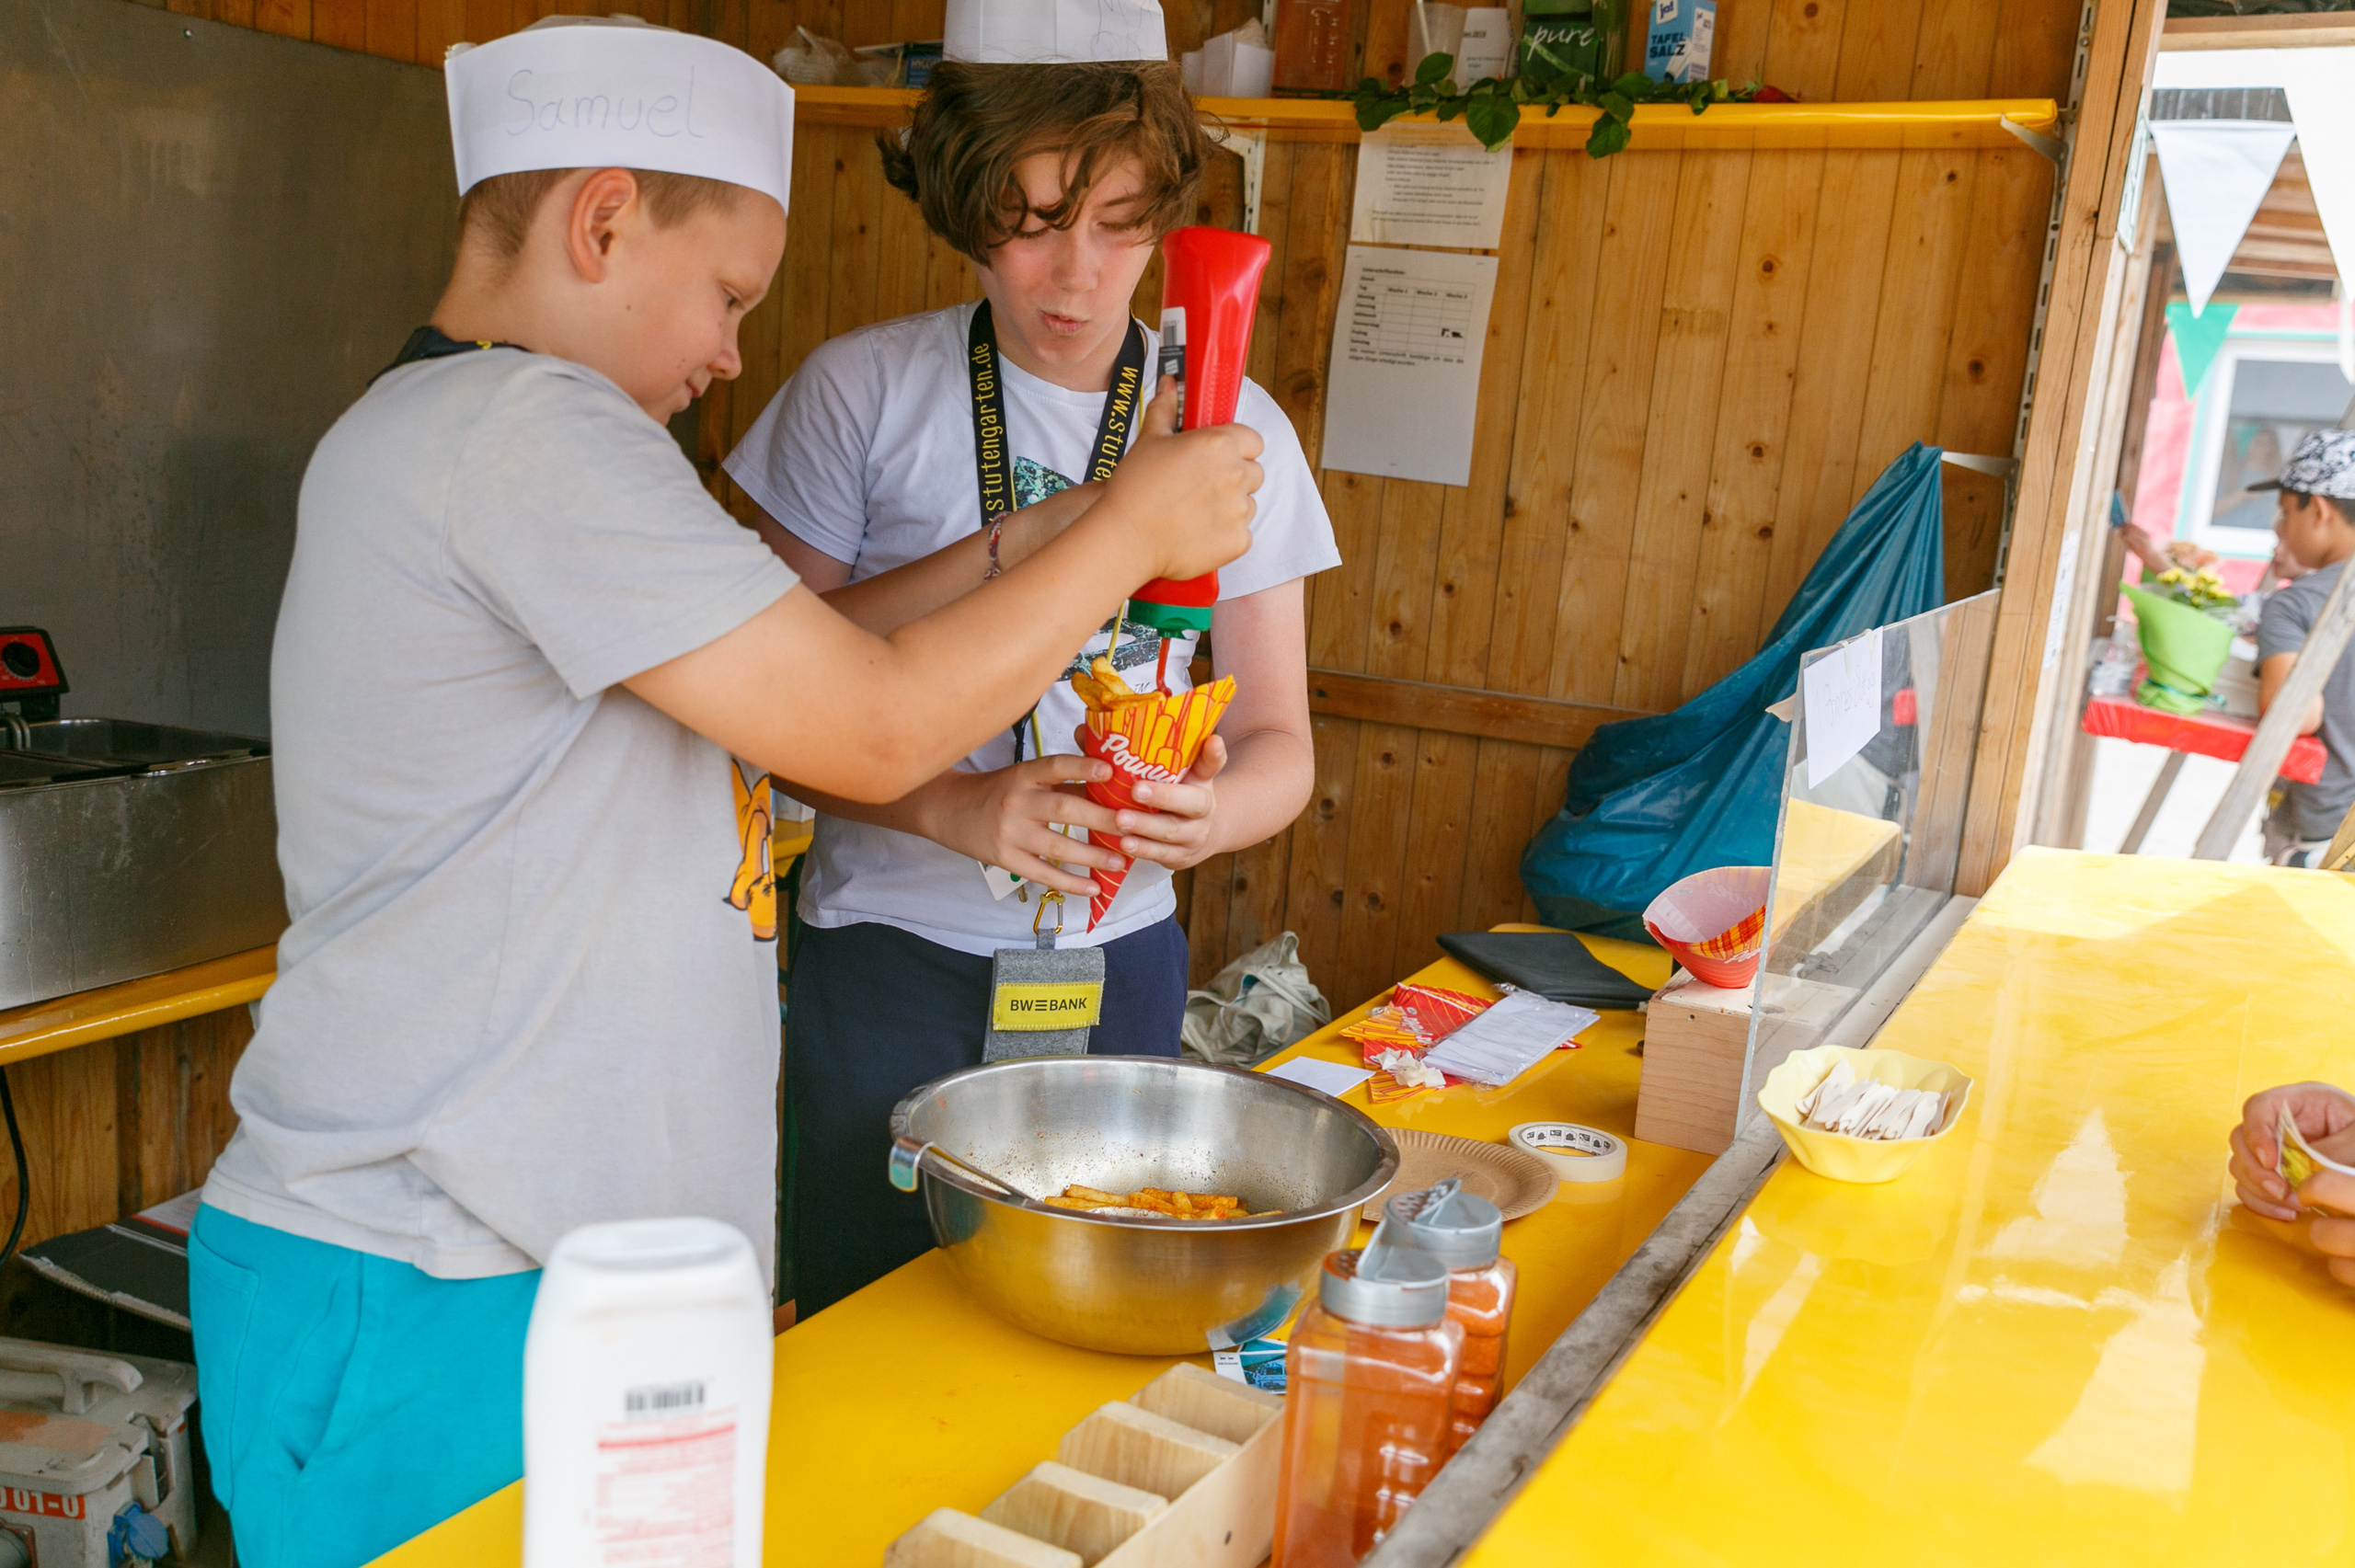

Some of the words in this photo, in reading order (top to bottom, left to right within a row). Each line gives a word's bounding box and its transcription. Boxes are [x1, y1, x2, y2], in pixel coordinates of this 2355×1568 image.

[1526, 25, 1595, 62] pure
[1648, 44, 1685, 58] SALZ
[1651, 32, 1685, 44] TAFEL
[506, 65, 705, 138] Samuel
[971, 342, 1005, 522] stutengarten.de
[1092, 366, 1139, 481] www.stute
[1100, 733, 1191, 784] Pomm
